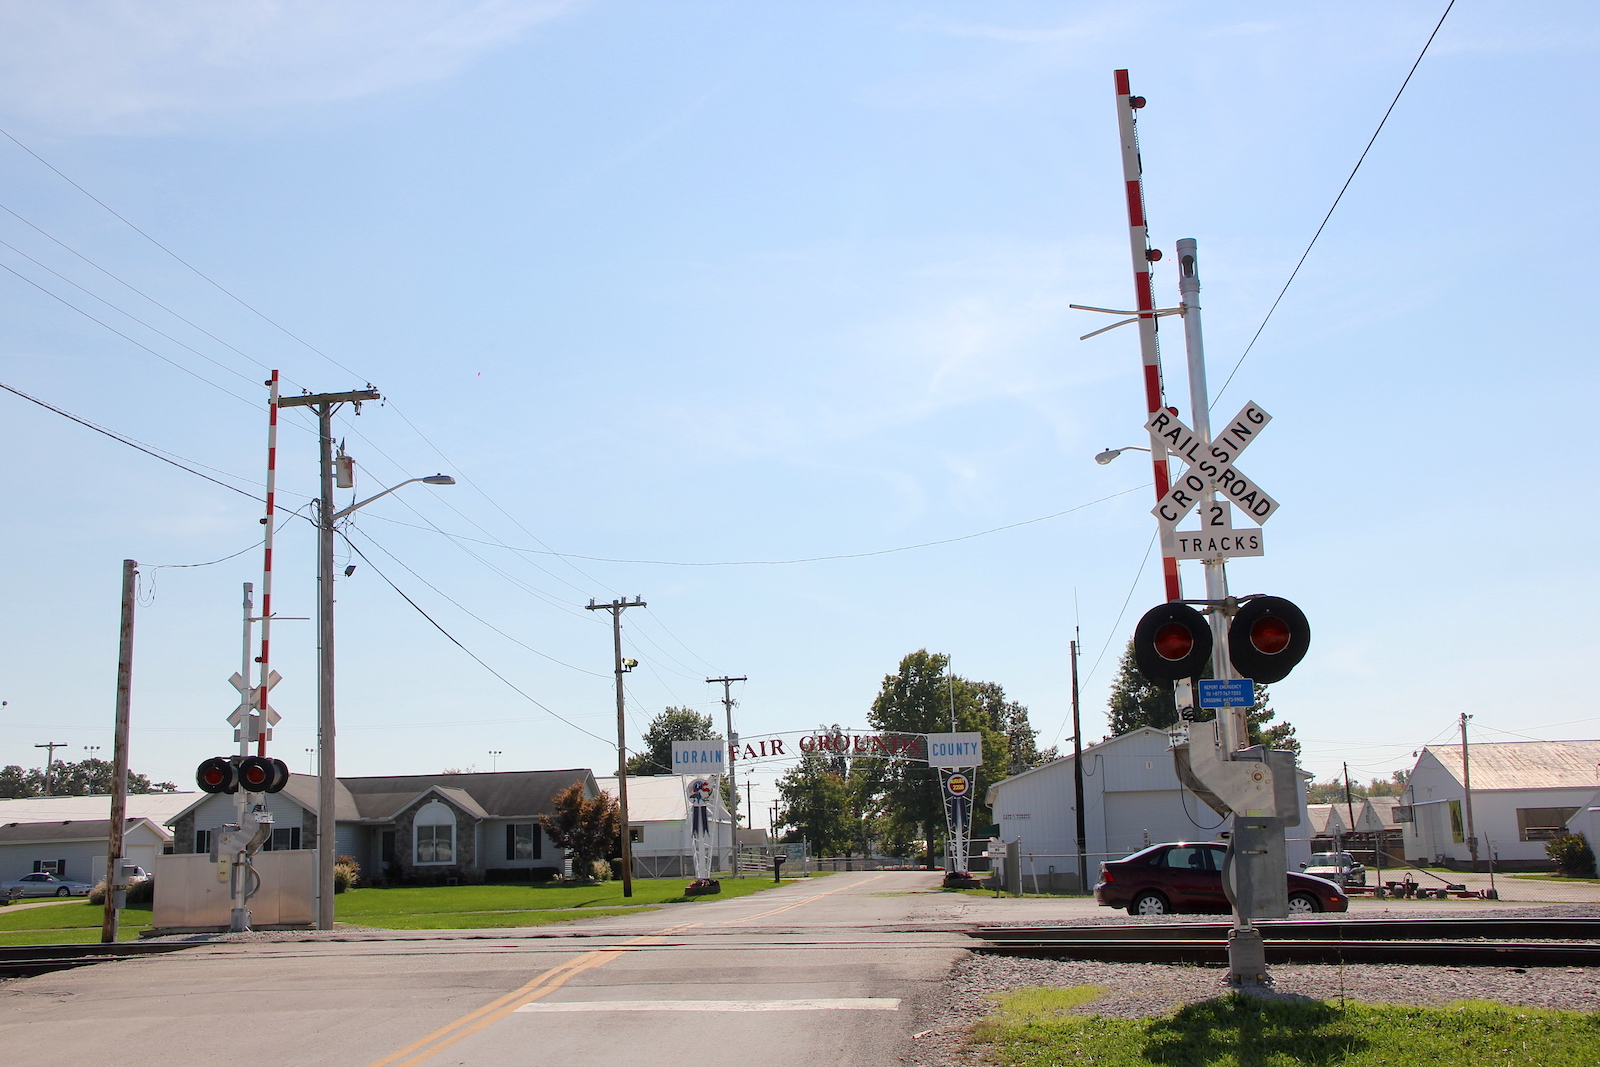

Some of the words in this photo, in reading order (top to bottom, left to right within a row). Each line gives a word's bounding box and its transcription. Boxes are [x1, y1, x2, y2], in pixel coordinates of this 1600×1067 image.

[1159, 407, 1265, 522] CROSSING
[1209, 506, 1225, 526] 2
[1179, 536, 1259, 552] TRACKS
[675, 750, 721, 764] LORAIN
[728, 739, 785, 762] FAIR
[799, 735, 922, 756] GROUNDS
[932, 742, 978, 757] COUNTY
